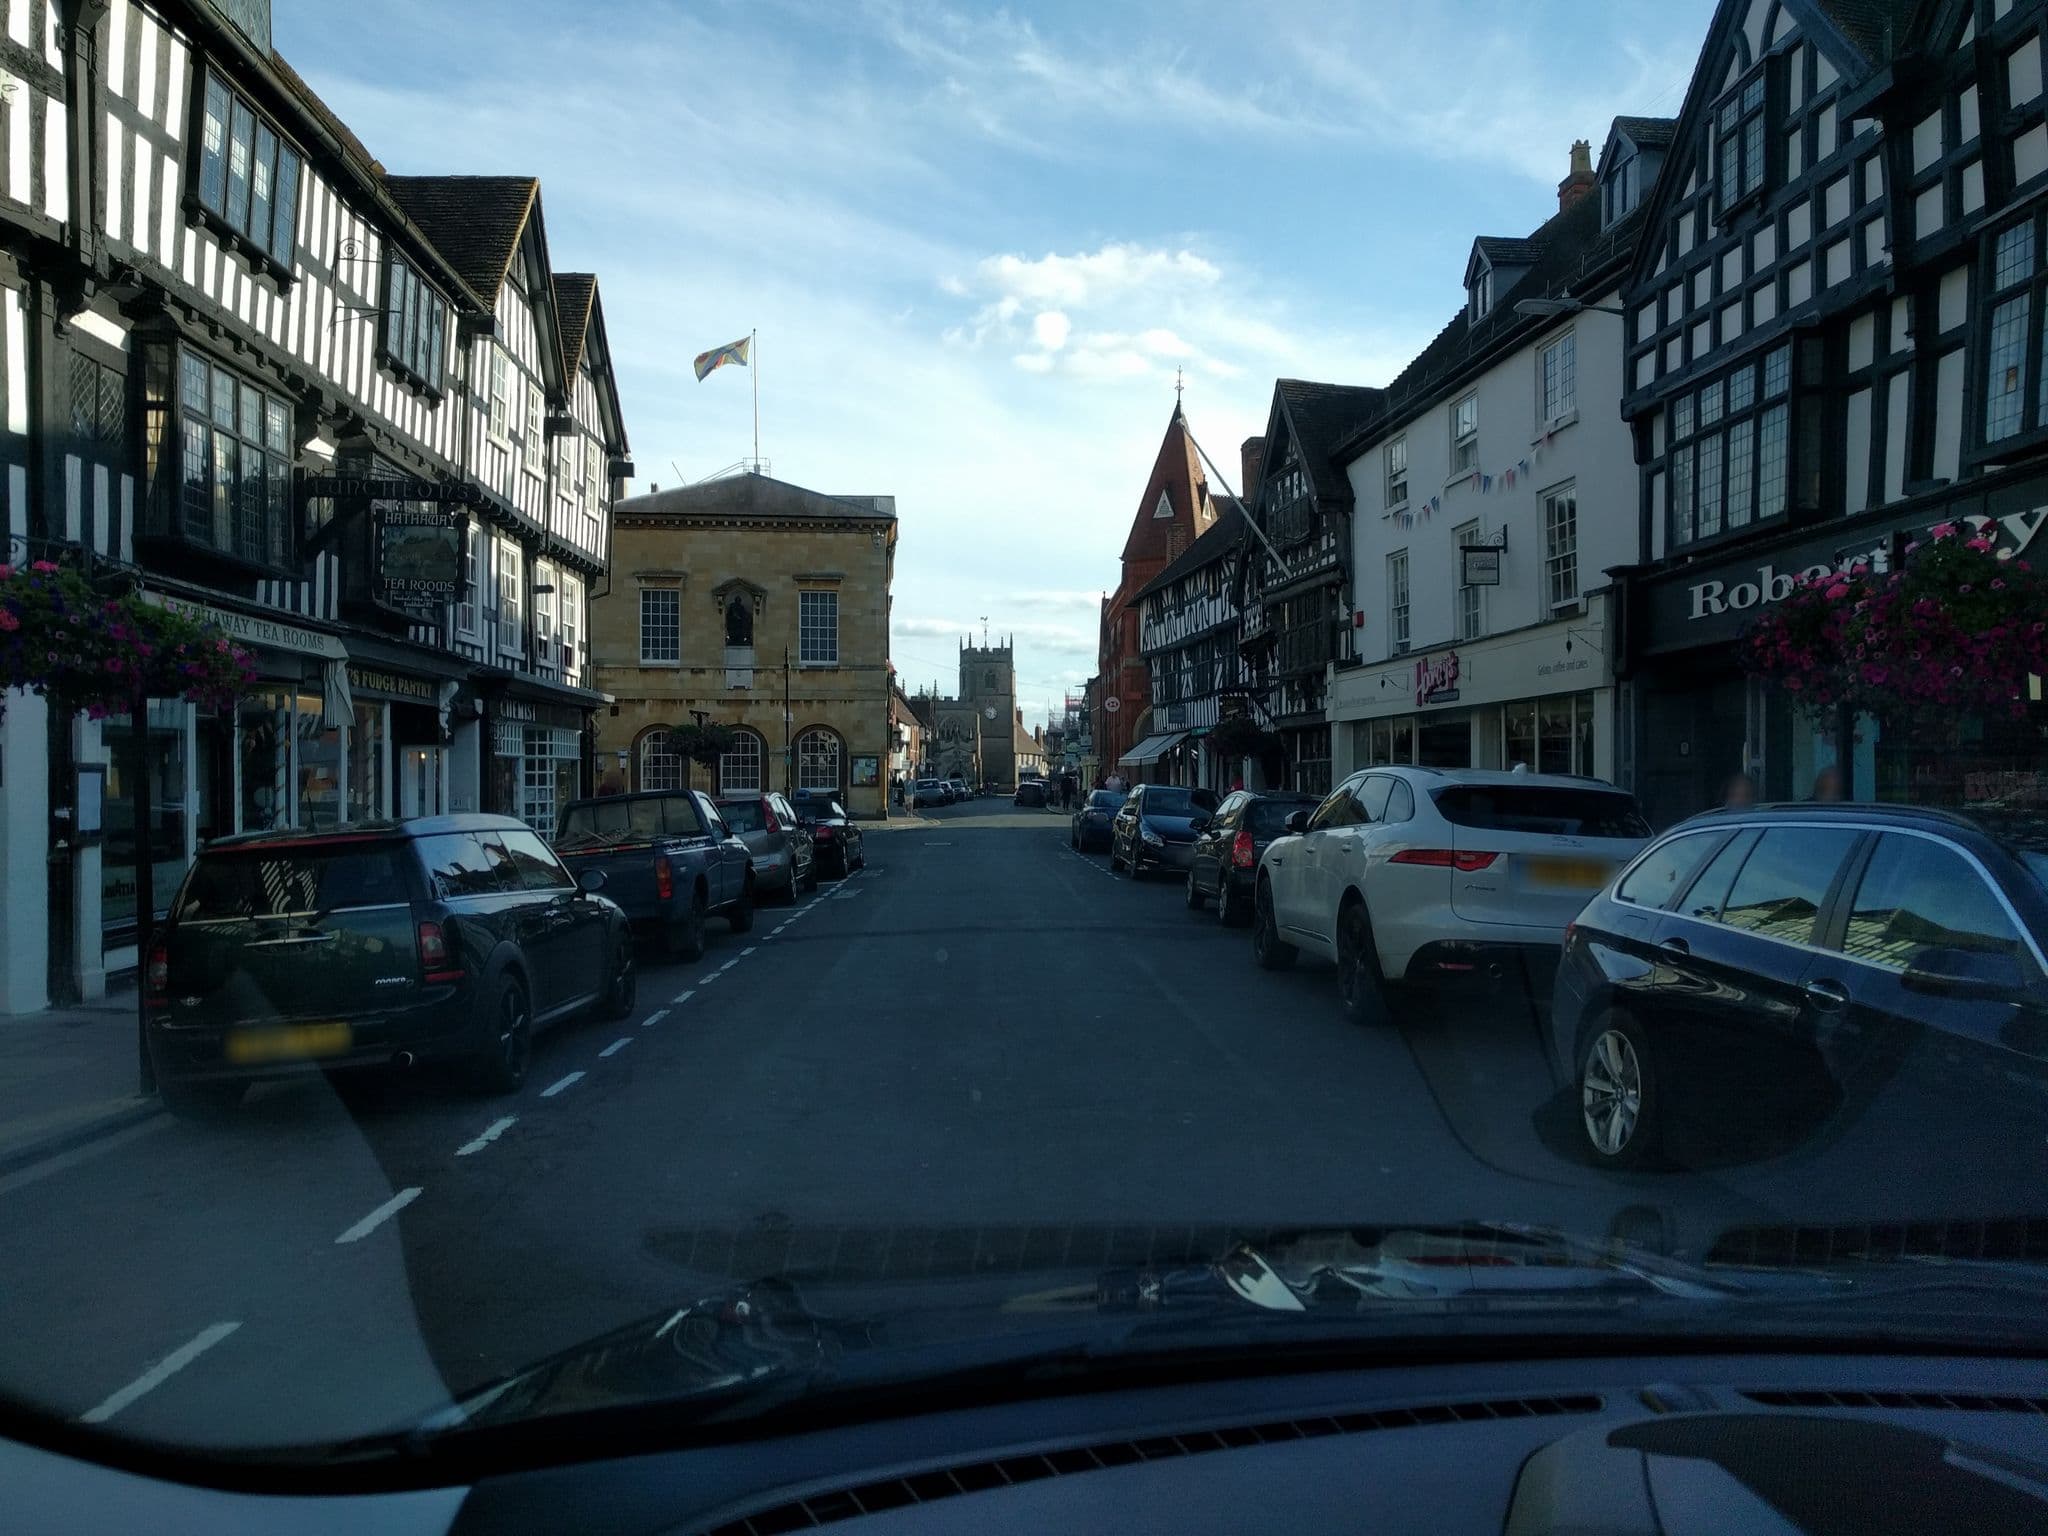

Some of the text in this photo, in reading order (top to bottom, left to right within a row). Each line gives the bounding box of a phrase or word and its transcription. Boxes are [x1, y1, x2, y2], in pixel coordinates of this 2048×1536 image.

[384, 512, 457, 527] HATHAWAY
[383, 577, 457, 593] TEA ROOMS
[253, 620, 280, 641] TEA
[283, 630, 325, 650] ROOMS
[361, 671, 396, 692] FUDGE
[397, 678, 432, 698] PANTRY
[499, 698, 537, 721] CHEMIST
